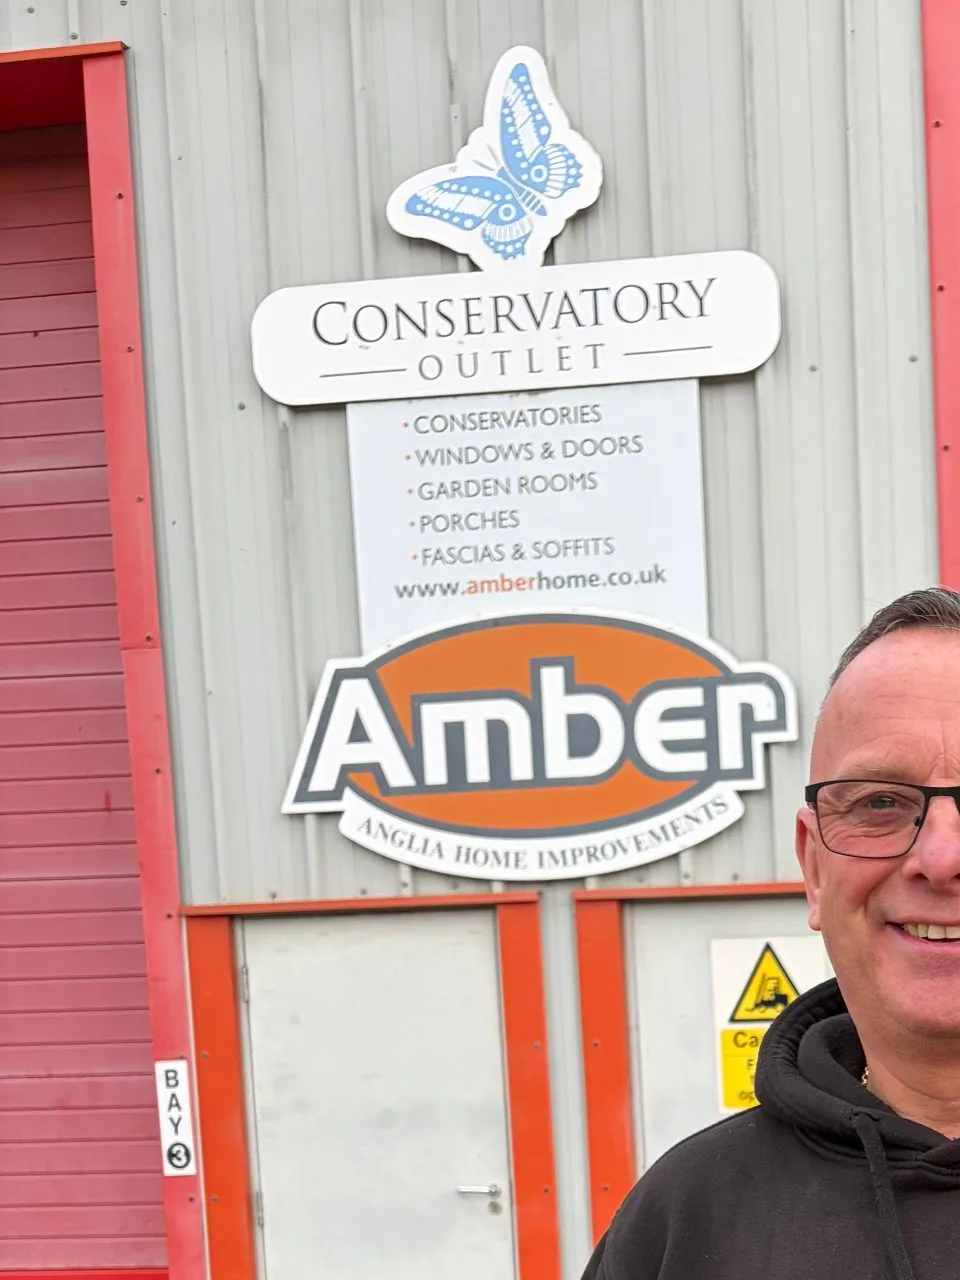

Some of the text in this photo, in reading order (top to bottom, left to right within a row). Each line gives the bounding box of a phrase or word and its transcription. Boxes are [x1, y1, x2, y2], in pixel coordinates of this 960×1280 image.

[312, 277, 717, 346] CONSERVATORY
[418, 344, 606, 381] OUTLET
[413, 404, 603, 434] CONSERVATORIES
[414, 435, 644, 467] WINDOWS & DOORS
[417, 471, 599, 501] GARDEN ROOMS
[419, 510, 521, 534] PORCHES
[421, 536, 616, 567] FASCIAS & SOFFITS
[394, 564, 668, 599] www.amberhome.co.uk
[307, 665, 778, 792] Amber
[357, 794, 730, 870] ANGLIA HOME IMPROVEMENTS
[164, 1069, 182, 1136] BAY
